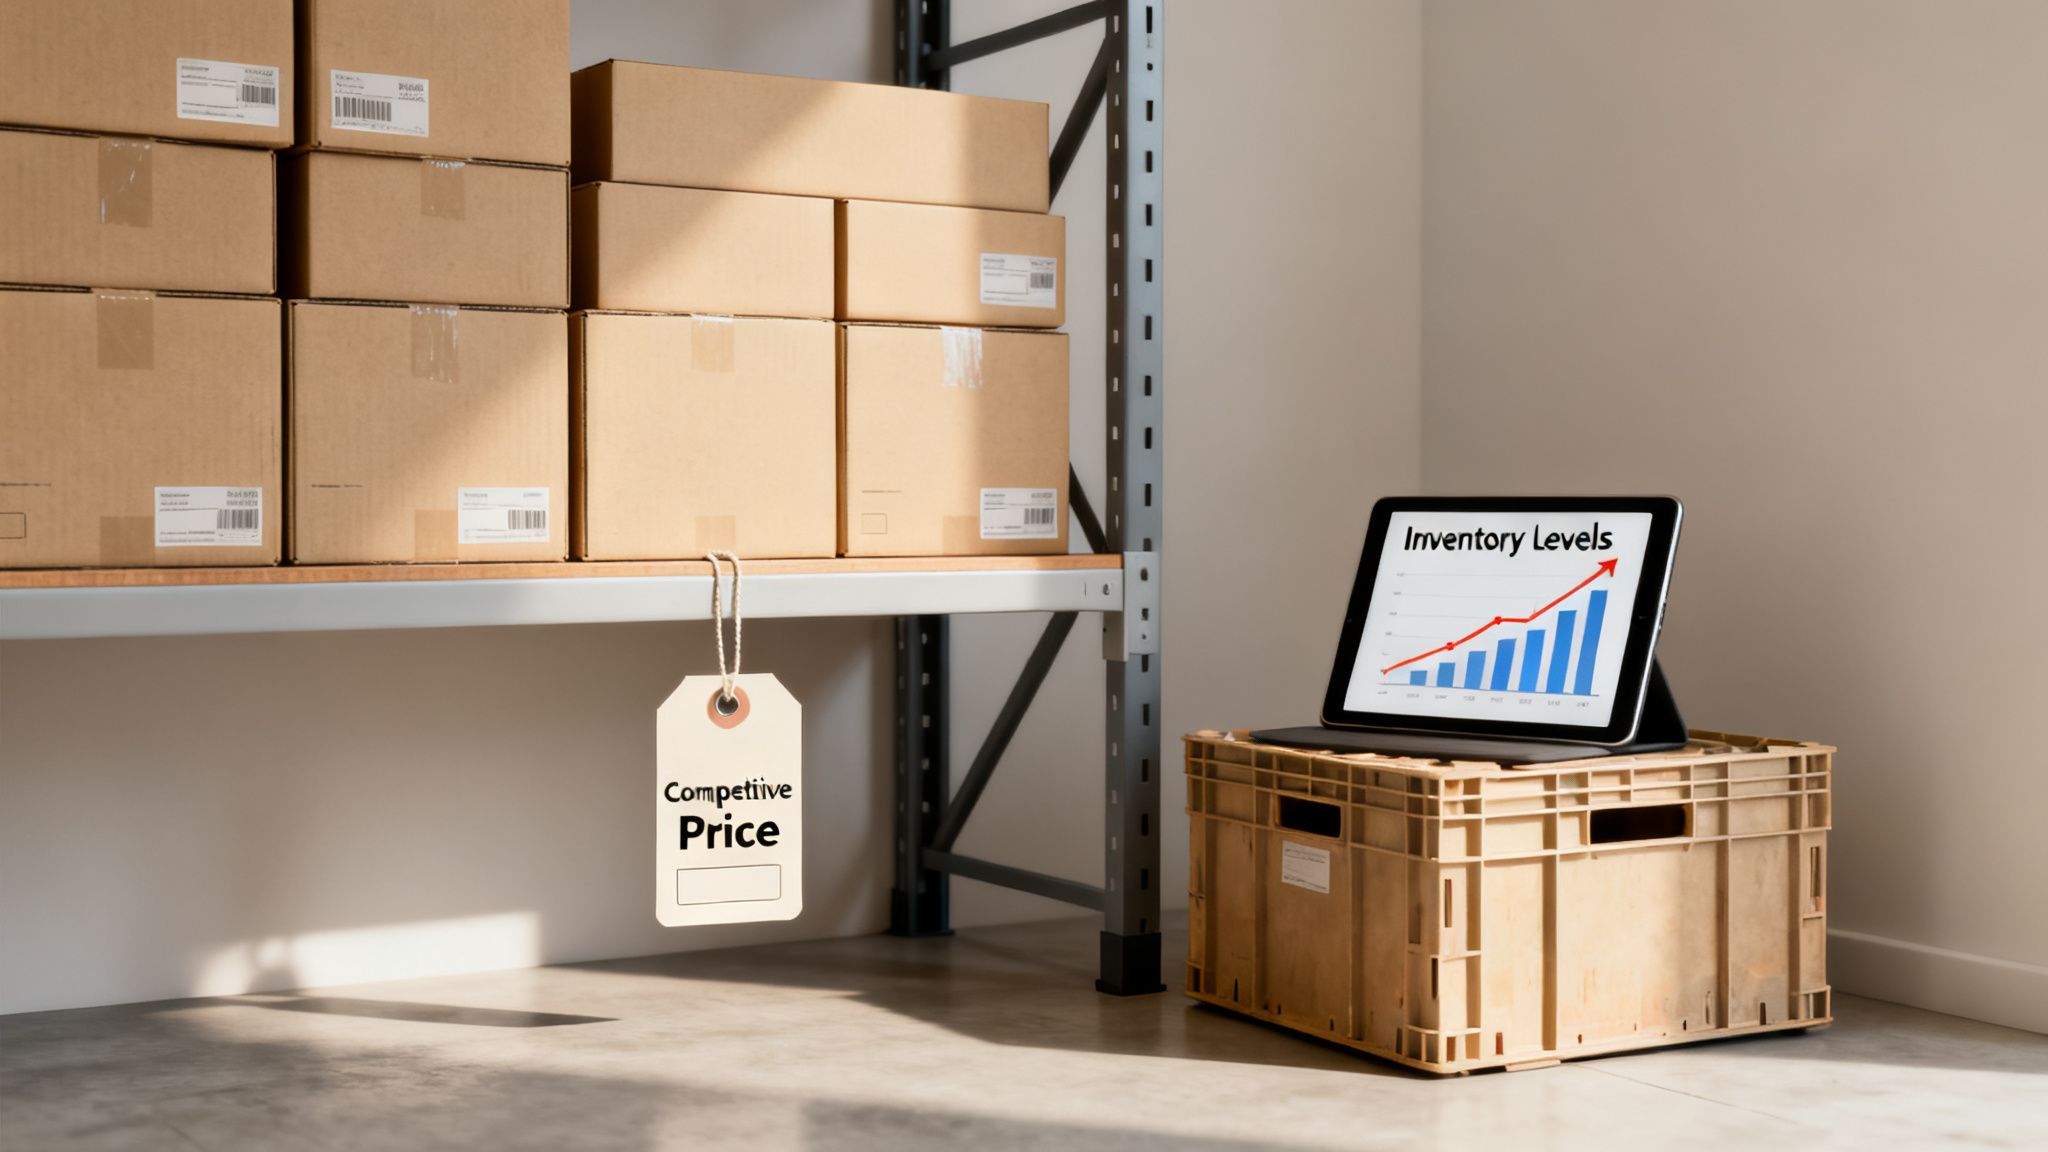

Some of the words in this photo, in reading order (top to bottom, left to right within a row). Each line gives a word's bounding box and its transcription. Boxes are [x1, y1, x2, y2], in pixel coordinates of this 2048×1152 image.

[1404, 526, 1526, 558] Inventory
[1533, 521, 1613, 552] Levels
[679, 813, 780, 851] Price
